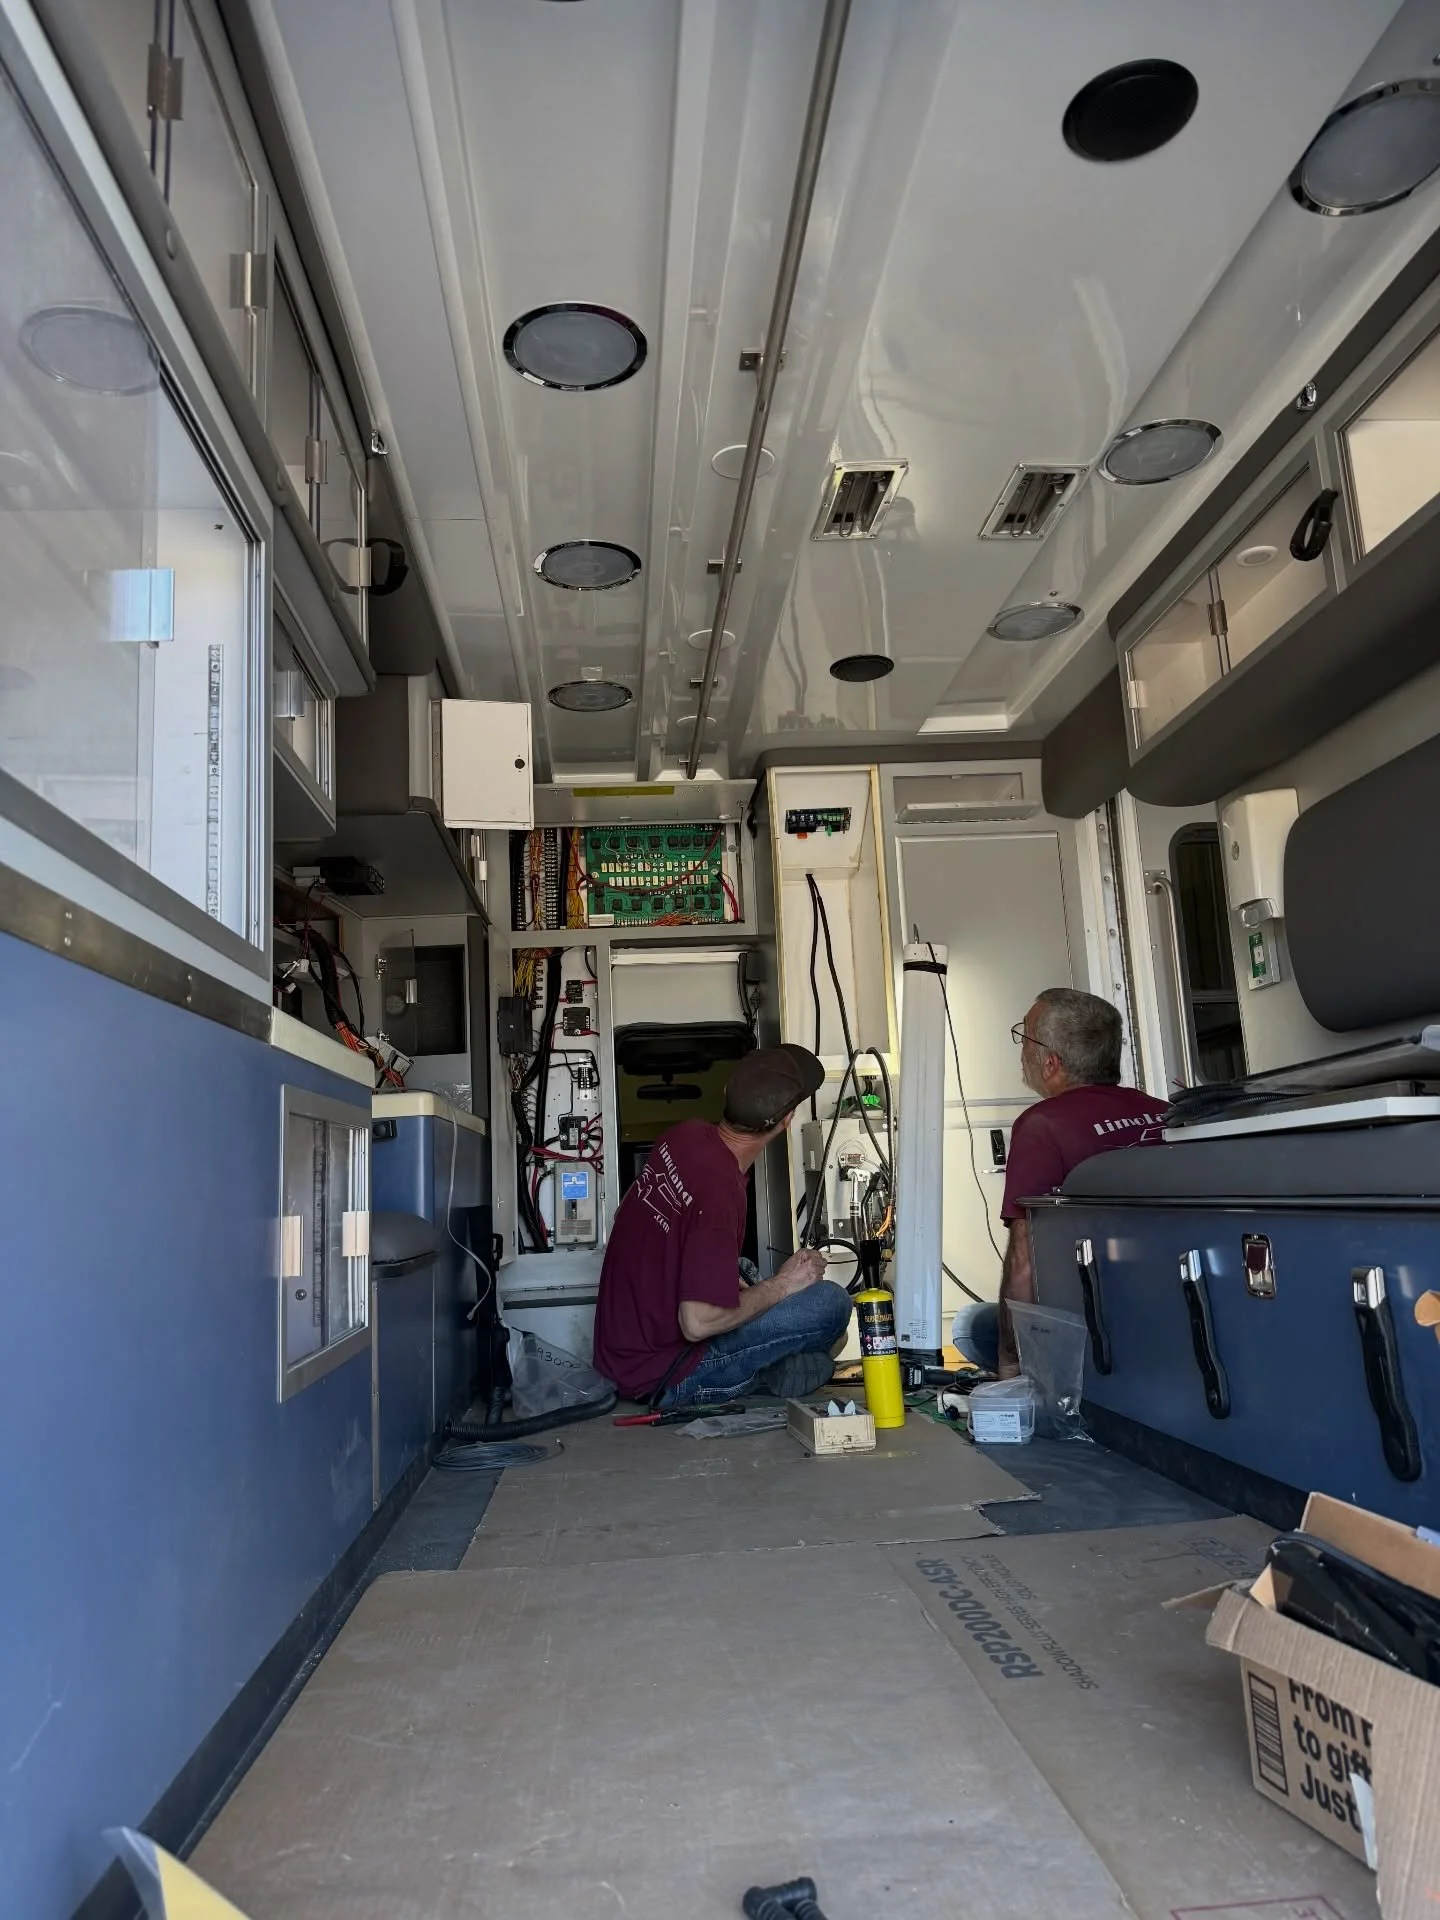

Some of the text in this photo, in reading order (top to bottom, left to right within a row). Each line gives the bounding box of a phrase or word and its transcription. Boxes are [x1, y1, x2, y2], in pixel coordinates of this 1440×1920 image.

[915, 1558, 1045, 1678] RSP200DC-ASR
[1293, 1714, 1322, 1761] to
[1300, 1763, 1363, 1834] Just
